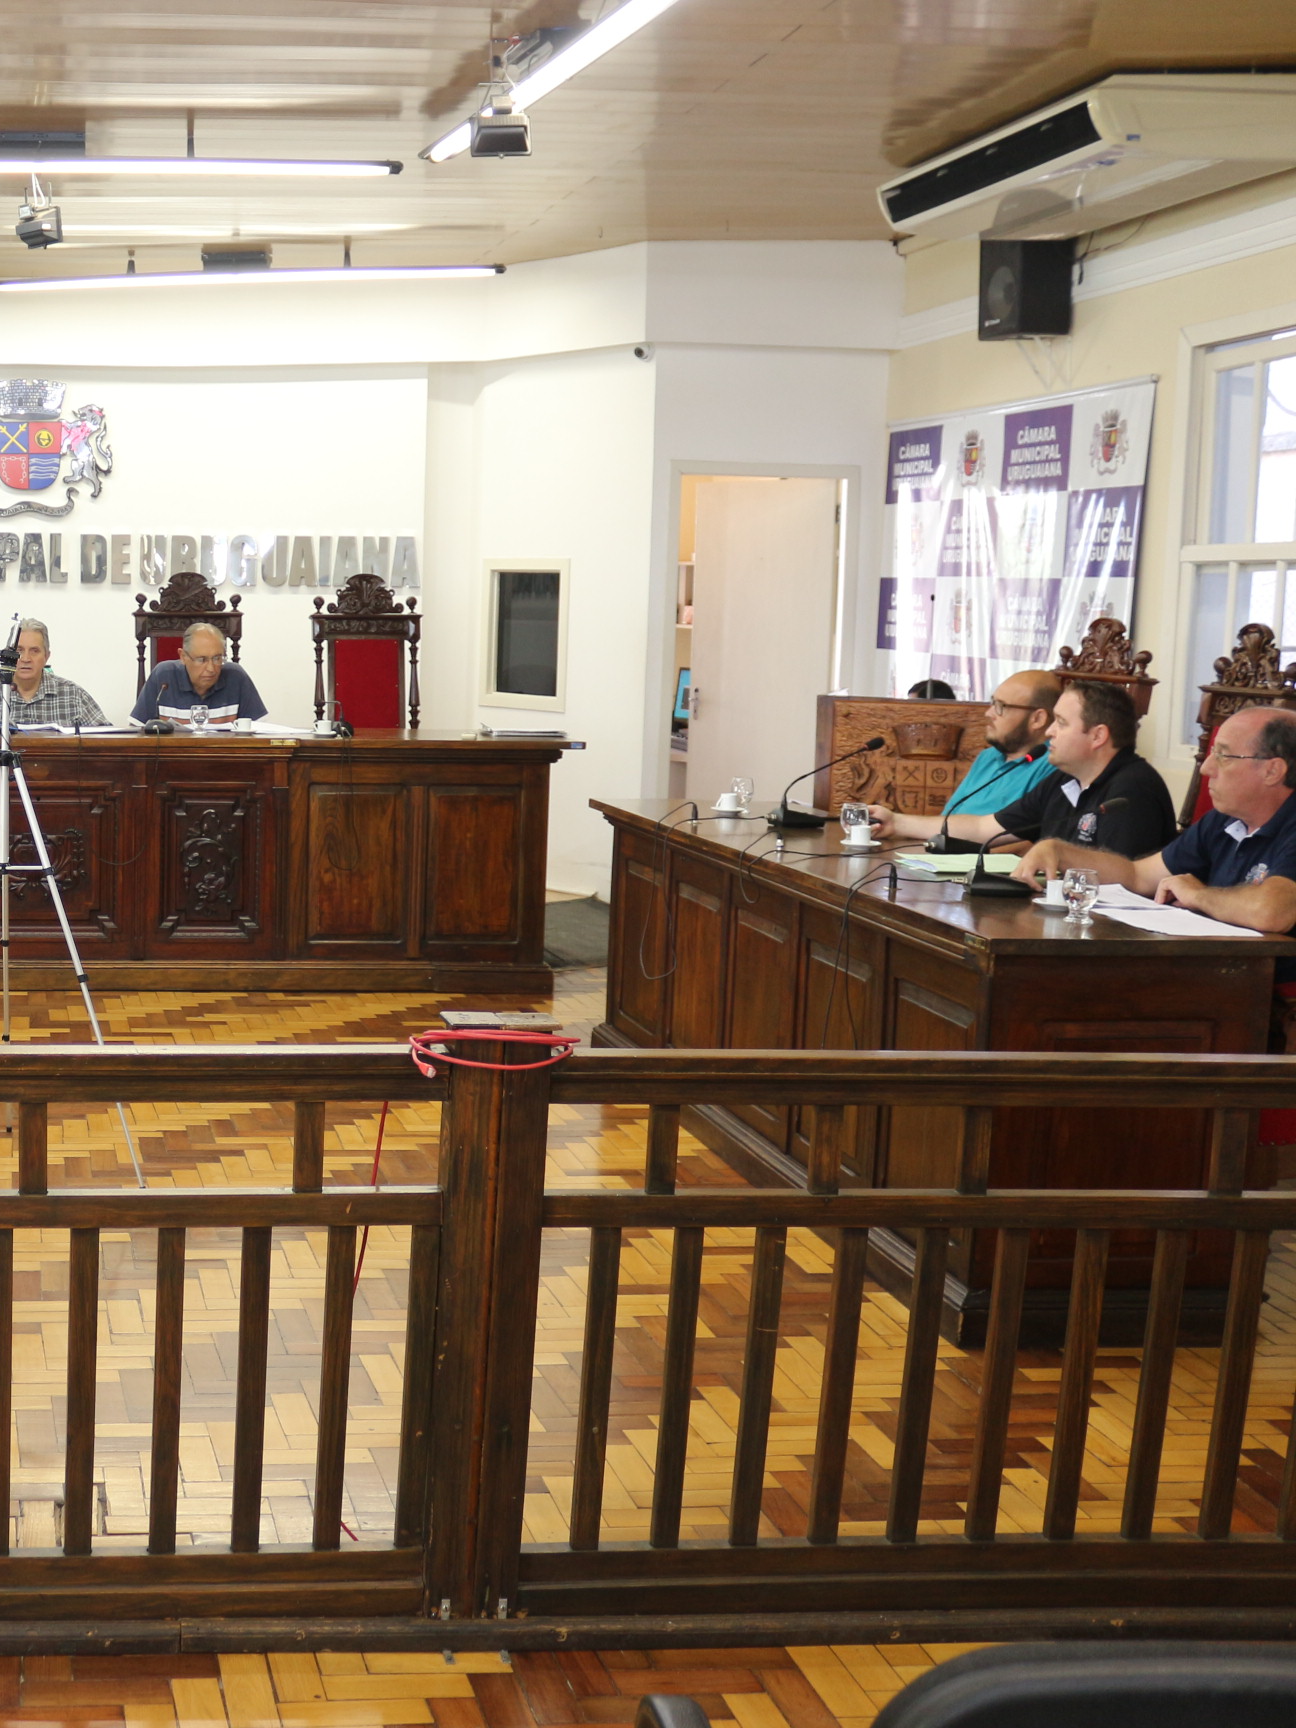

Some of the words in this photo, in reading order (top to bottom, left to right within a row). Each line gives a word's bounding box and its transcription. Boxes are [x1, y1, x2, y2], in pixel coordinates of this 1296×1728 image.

[1017, 426, 1057, 446] CÂMARA
[898, 442, 931, 460] CÂMARA
[1010, 443, 1061, 464] MUNICIPAL
[893, 459, 934, 477] MUNICIPAL
[1007, 461, 1062, 481] URUGUAIANA
[80, 533, 132, 585] DE
[139, 534, 420, 588] URUGUAIANA
